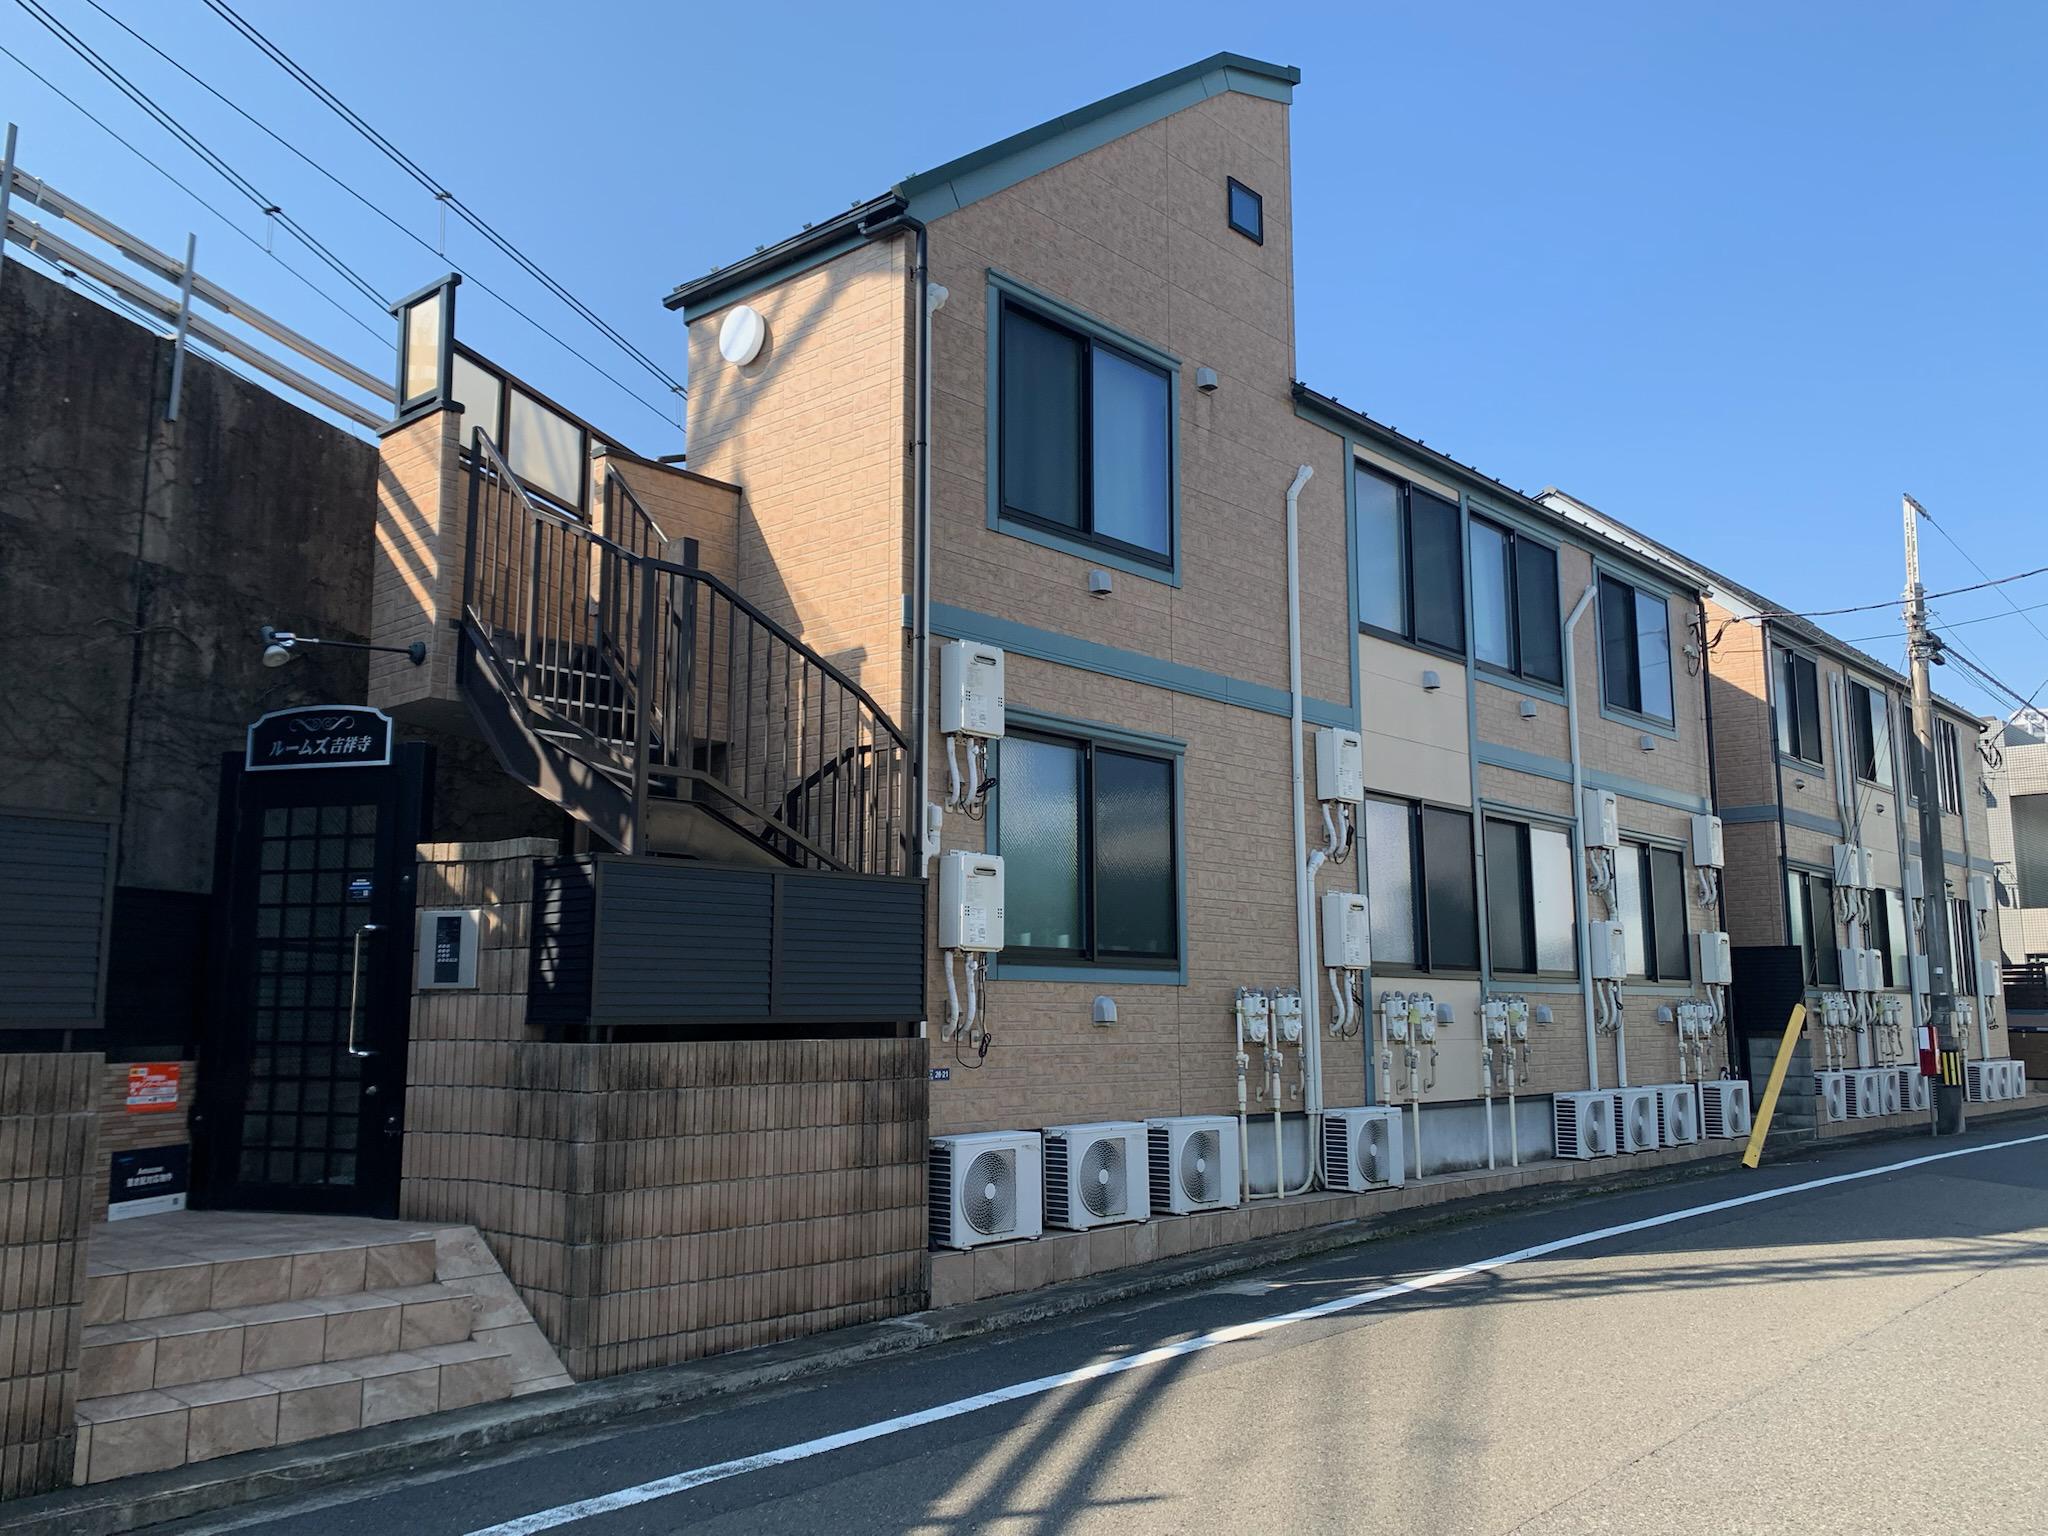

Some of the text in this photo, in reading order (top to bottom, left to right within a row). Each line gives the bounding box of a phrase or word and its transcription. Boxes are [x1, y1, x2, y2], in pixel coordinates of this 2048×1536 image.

[269, 735, 373, 757] ルームズ吉祥寺
